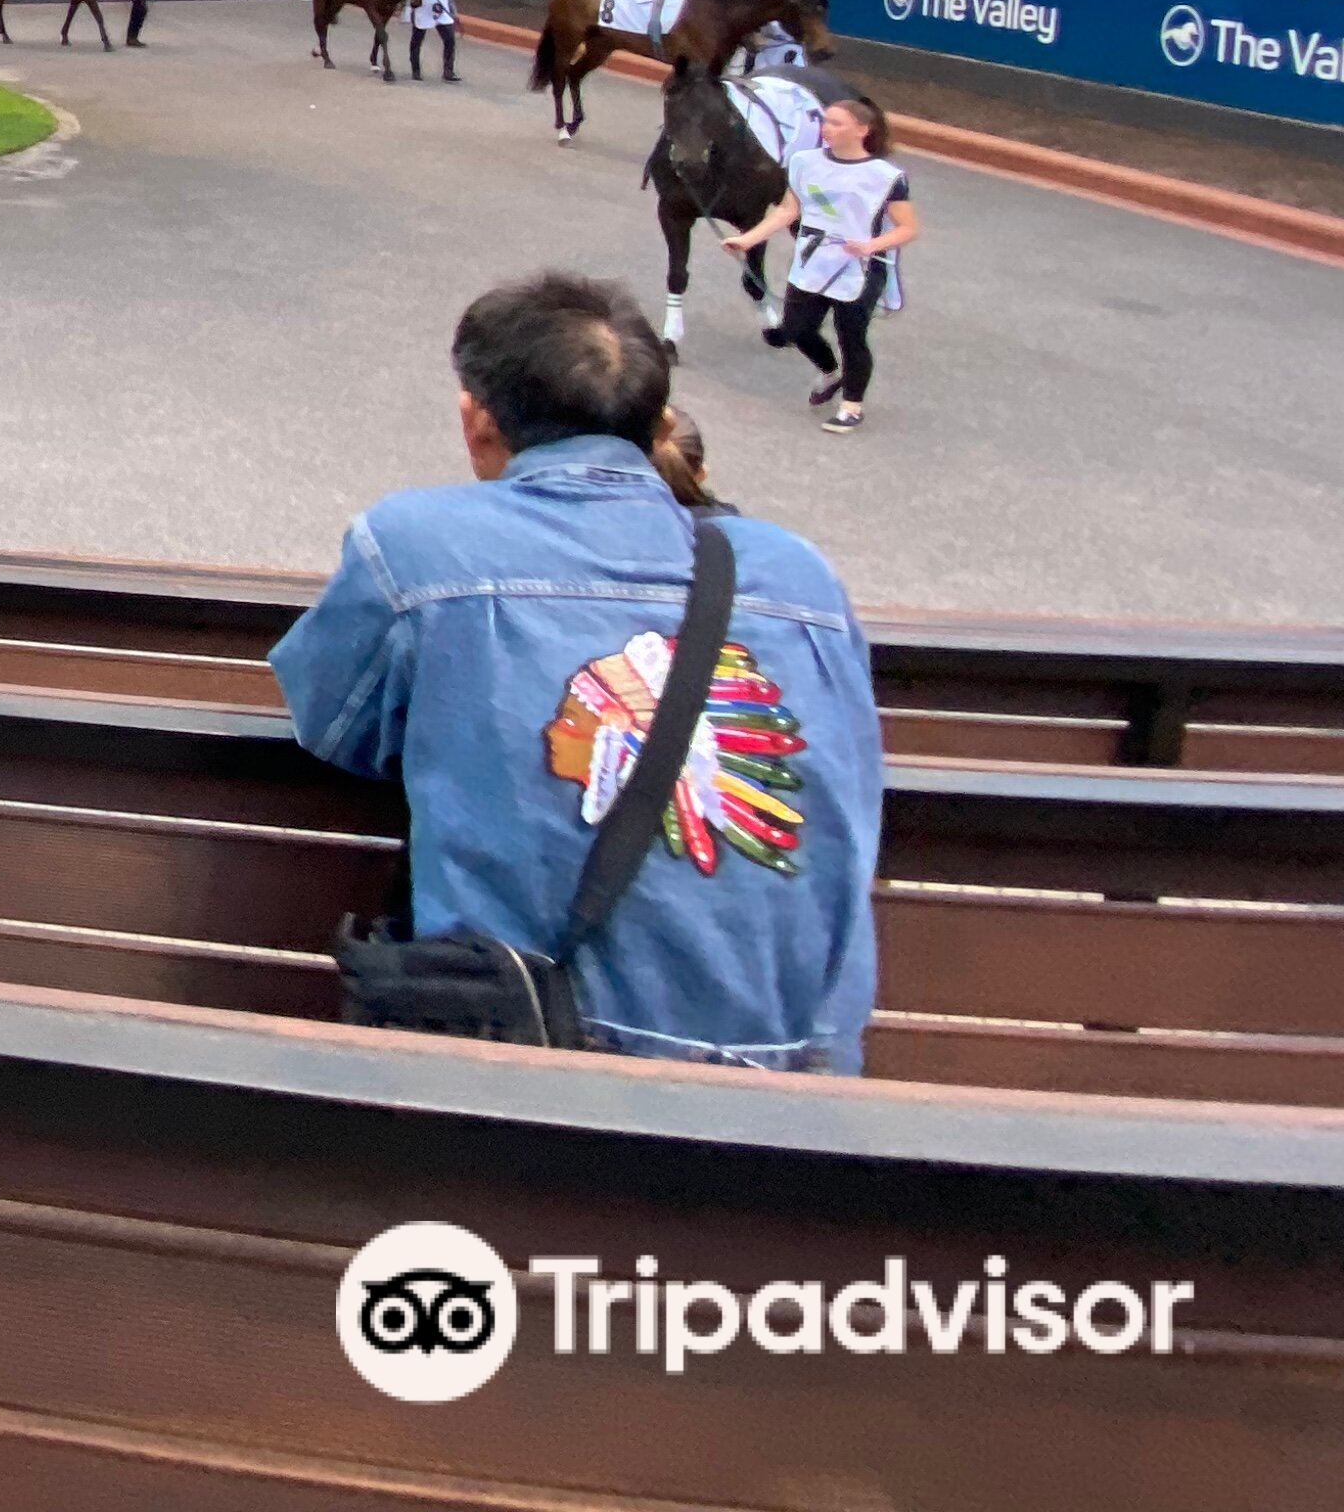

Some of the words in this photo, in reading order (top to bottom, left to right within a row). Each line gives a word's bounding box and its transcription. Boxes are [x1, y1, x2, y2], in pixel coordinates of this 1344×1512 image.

[1210, 19, 1280, 71] The
[1287, 29, 1344, 83] Val
[801, 225, 826, 268] 7
